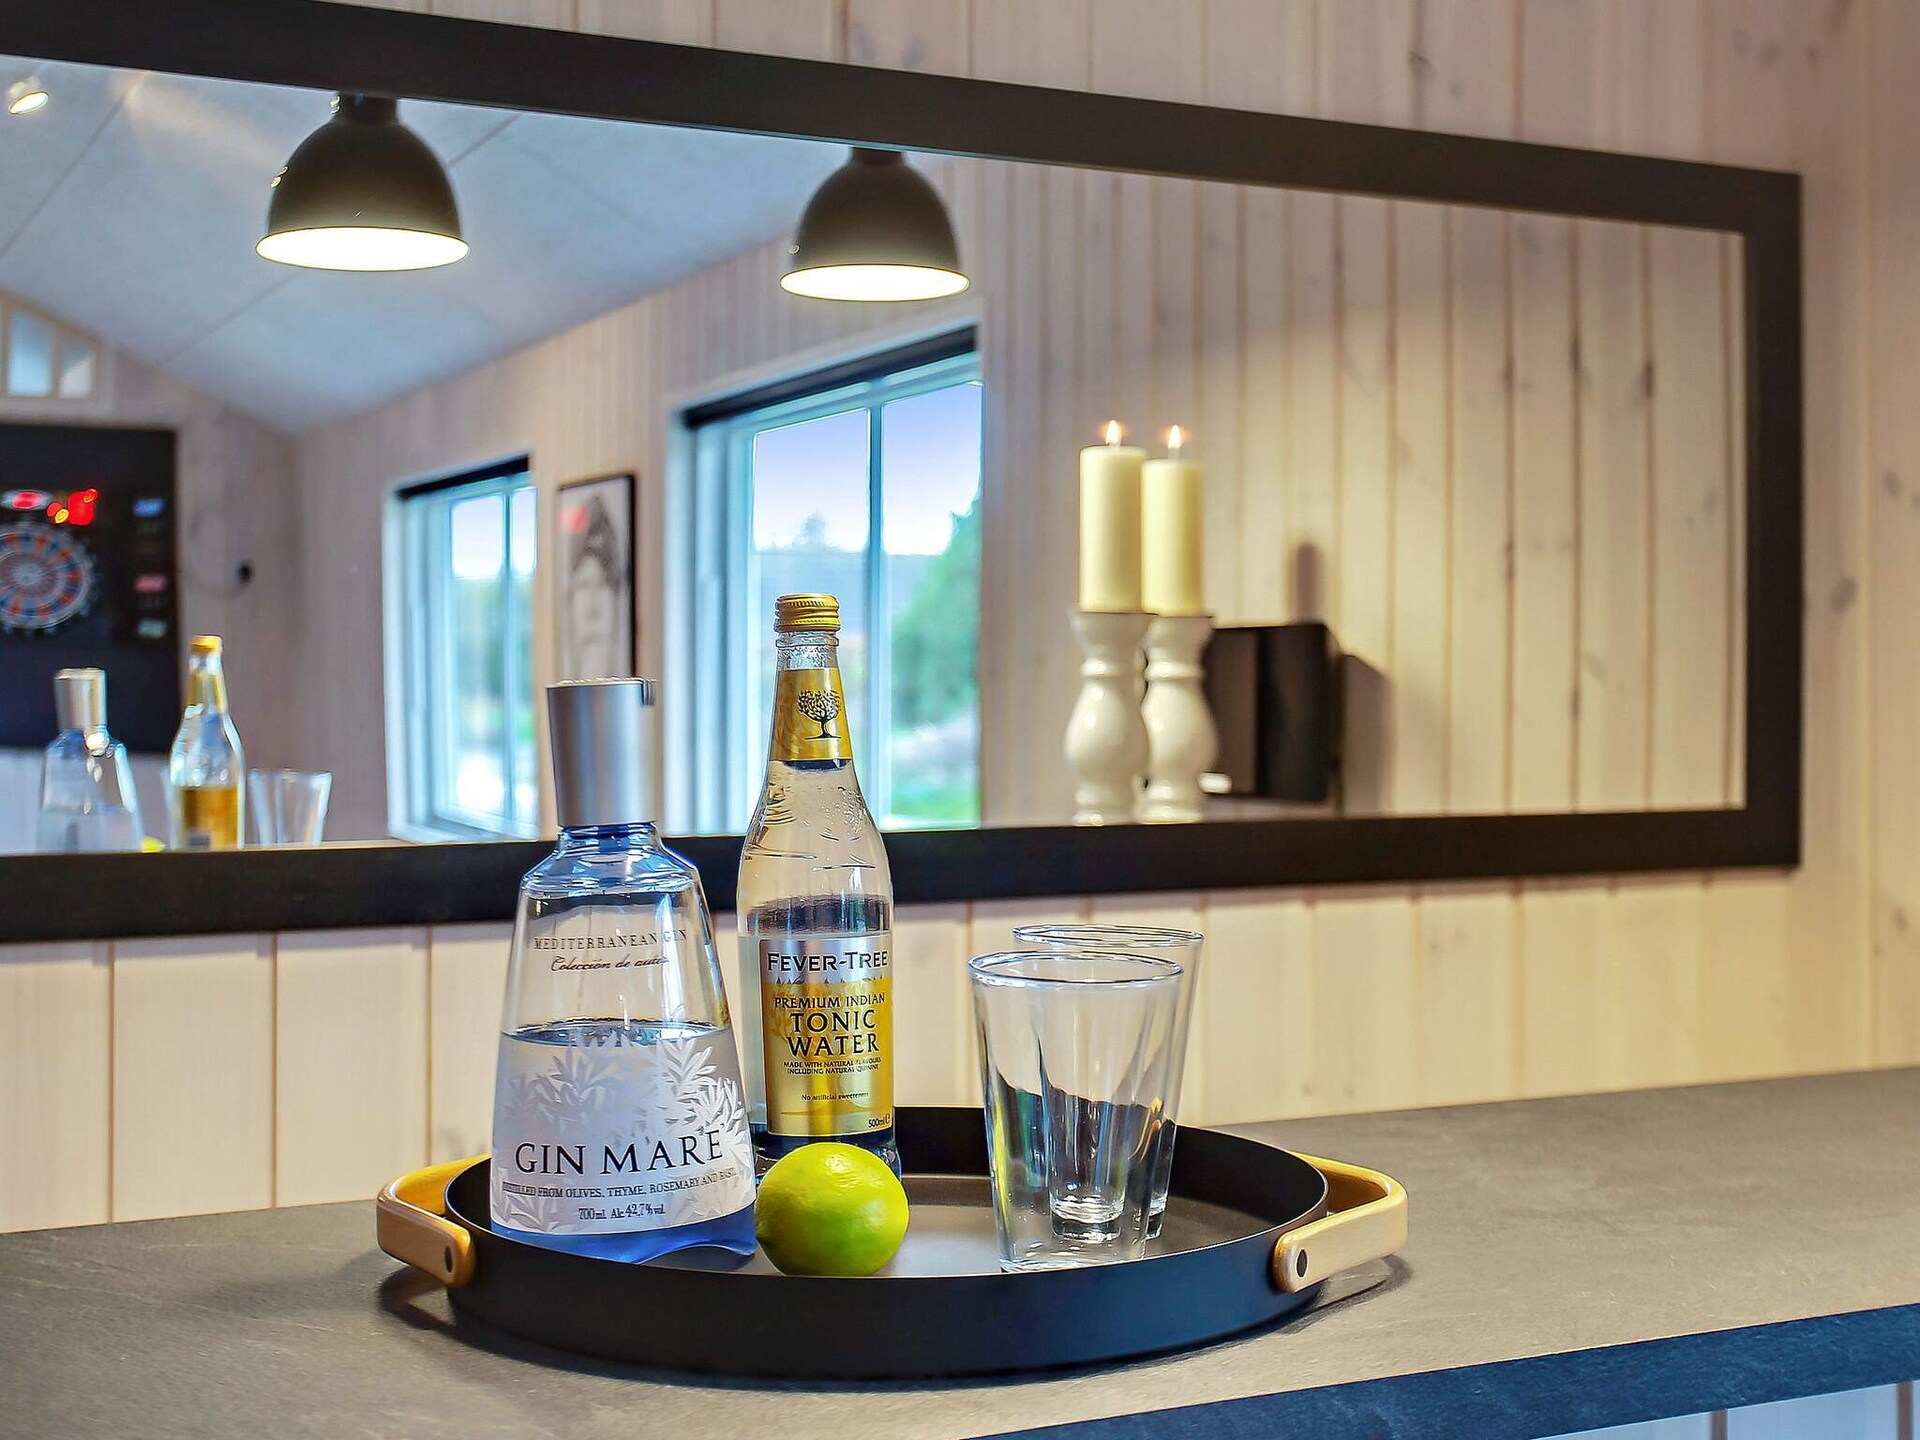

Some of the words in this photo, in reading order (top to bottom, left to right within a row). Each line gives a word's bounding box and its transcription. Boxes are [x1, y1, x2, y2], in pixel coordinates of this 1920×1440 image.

[534, 932, 658, 950] MEDITERRANEAN
[615, 953, 630, 969] de
[767, 950, 888, 972] FEVER-TREE
[774, 996, 841, 1009] PREMIUM
[846, 992, 885, 1007] INDIAN
[790, 1009, 876, 1033] TONIC
[787, 1033, 879, 1057] WATER
[824, 1060, 854, 1068] NATURAL
[812, 1093, 837, 1101] artificial
[515, 1143, 587, 1175] GIN
[600, 1130, 723, 1175] MARE
[538, 1187, 563, 1198] FROM
[650, 1177, 702, 1194] ROSEMARY
[700, 1172, 719, 1185] AND
